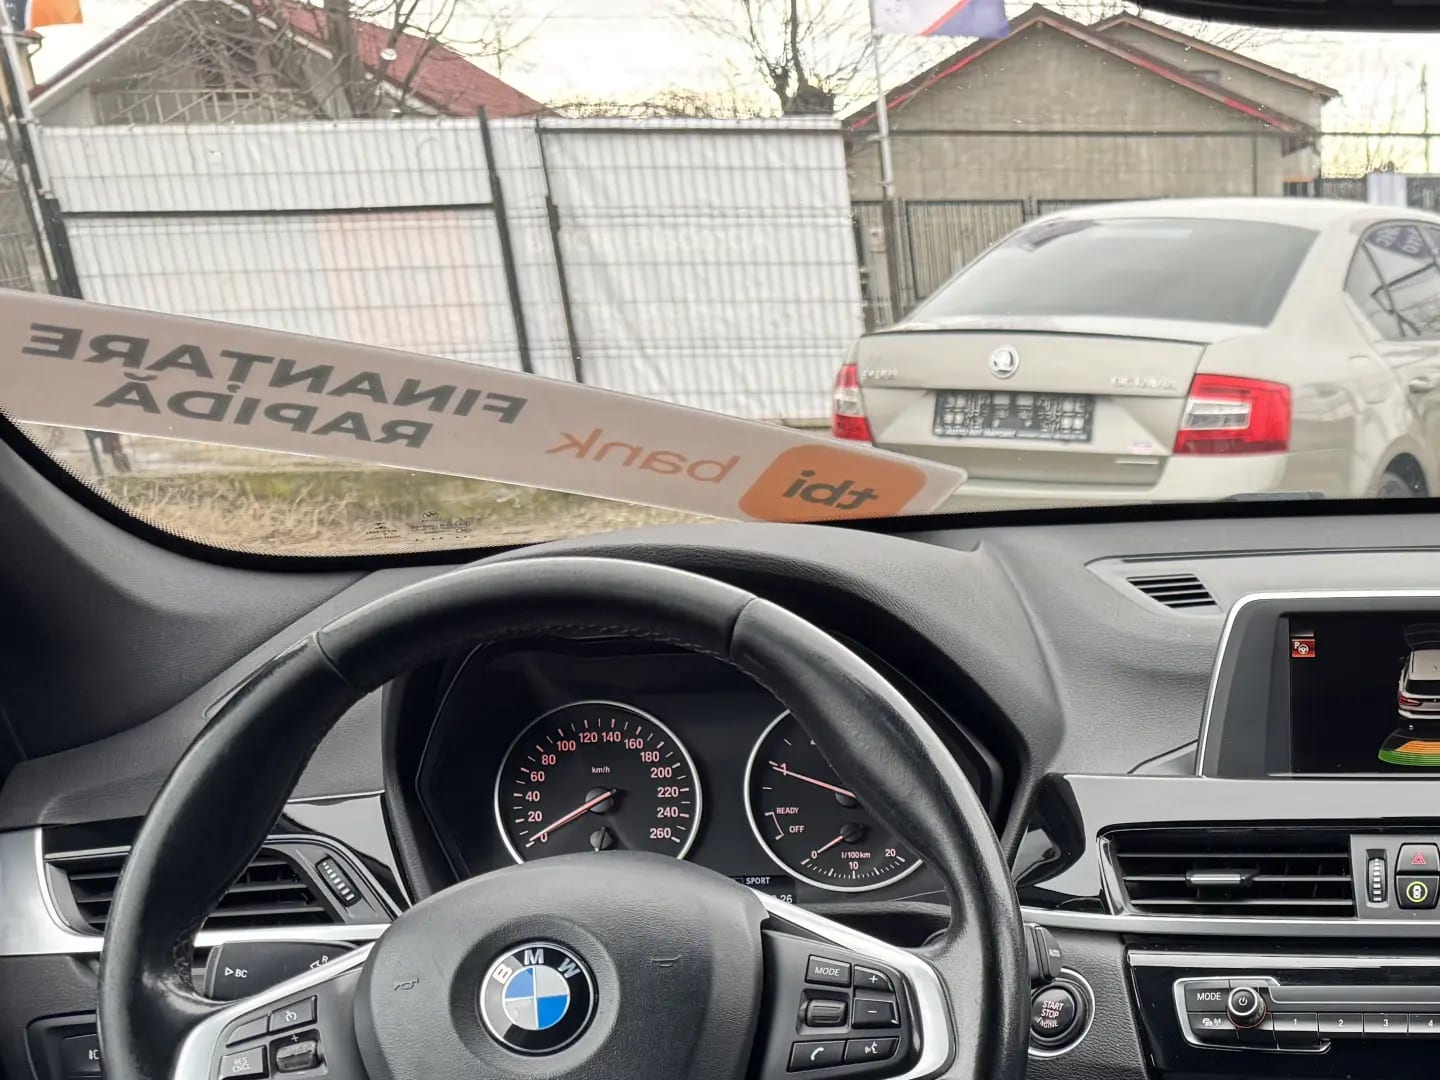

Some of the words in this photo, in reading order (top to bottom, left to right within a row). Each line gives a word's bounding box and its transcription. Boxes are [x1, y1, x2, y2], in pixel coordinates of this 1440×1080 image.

[578, 732, 598, 743] 120
[601, 731, 622, 743] 140
[556, 740, 576, 751] 100
[624, 738, 644, 750] 160
[541, 754, 556, 765] 80
[640, 751, 660, 762] 180
[591, 766, 611, 774] km/h
[650, 767, 672, 778] 200
[530, 771, 545, 782] 60
[525, 790, 540, 802] 40
[657, 786, 679, 798] 220
[527, 811, 543, 822] 20
[657, 806, 679, 818] 240
[649, 828, 672, 839] 260
[789, 825, 805, 833] OFF
[811, 850, 818, 859] 0
[885, 848, 896, 857] 20
[848, 861, 859, 870] 10
[746, 876, 770, 885] SPORT
[492, 948, 581, 984] BMW
[814, 966, 840, 976] MODE
[235, 968, 248, 978] BC
[1197, 992, 1221, 1001] MODE
[1042, 1000, 1064, 1011] START
[1041, 1008, 1060, 1018] STOP
[1293, 1018, 1297, 1026] 1
[1338, 1019, 1344, 1027] 2
[1383, 1019, 1389, 1027] 3
[1428, 1019, 1434, 1028] 4
